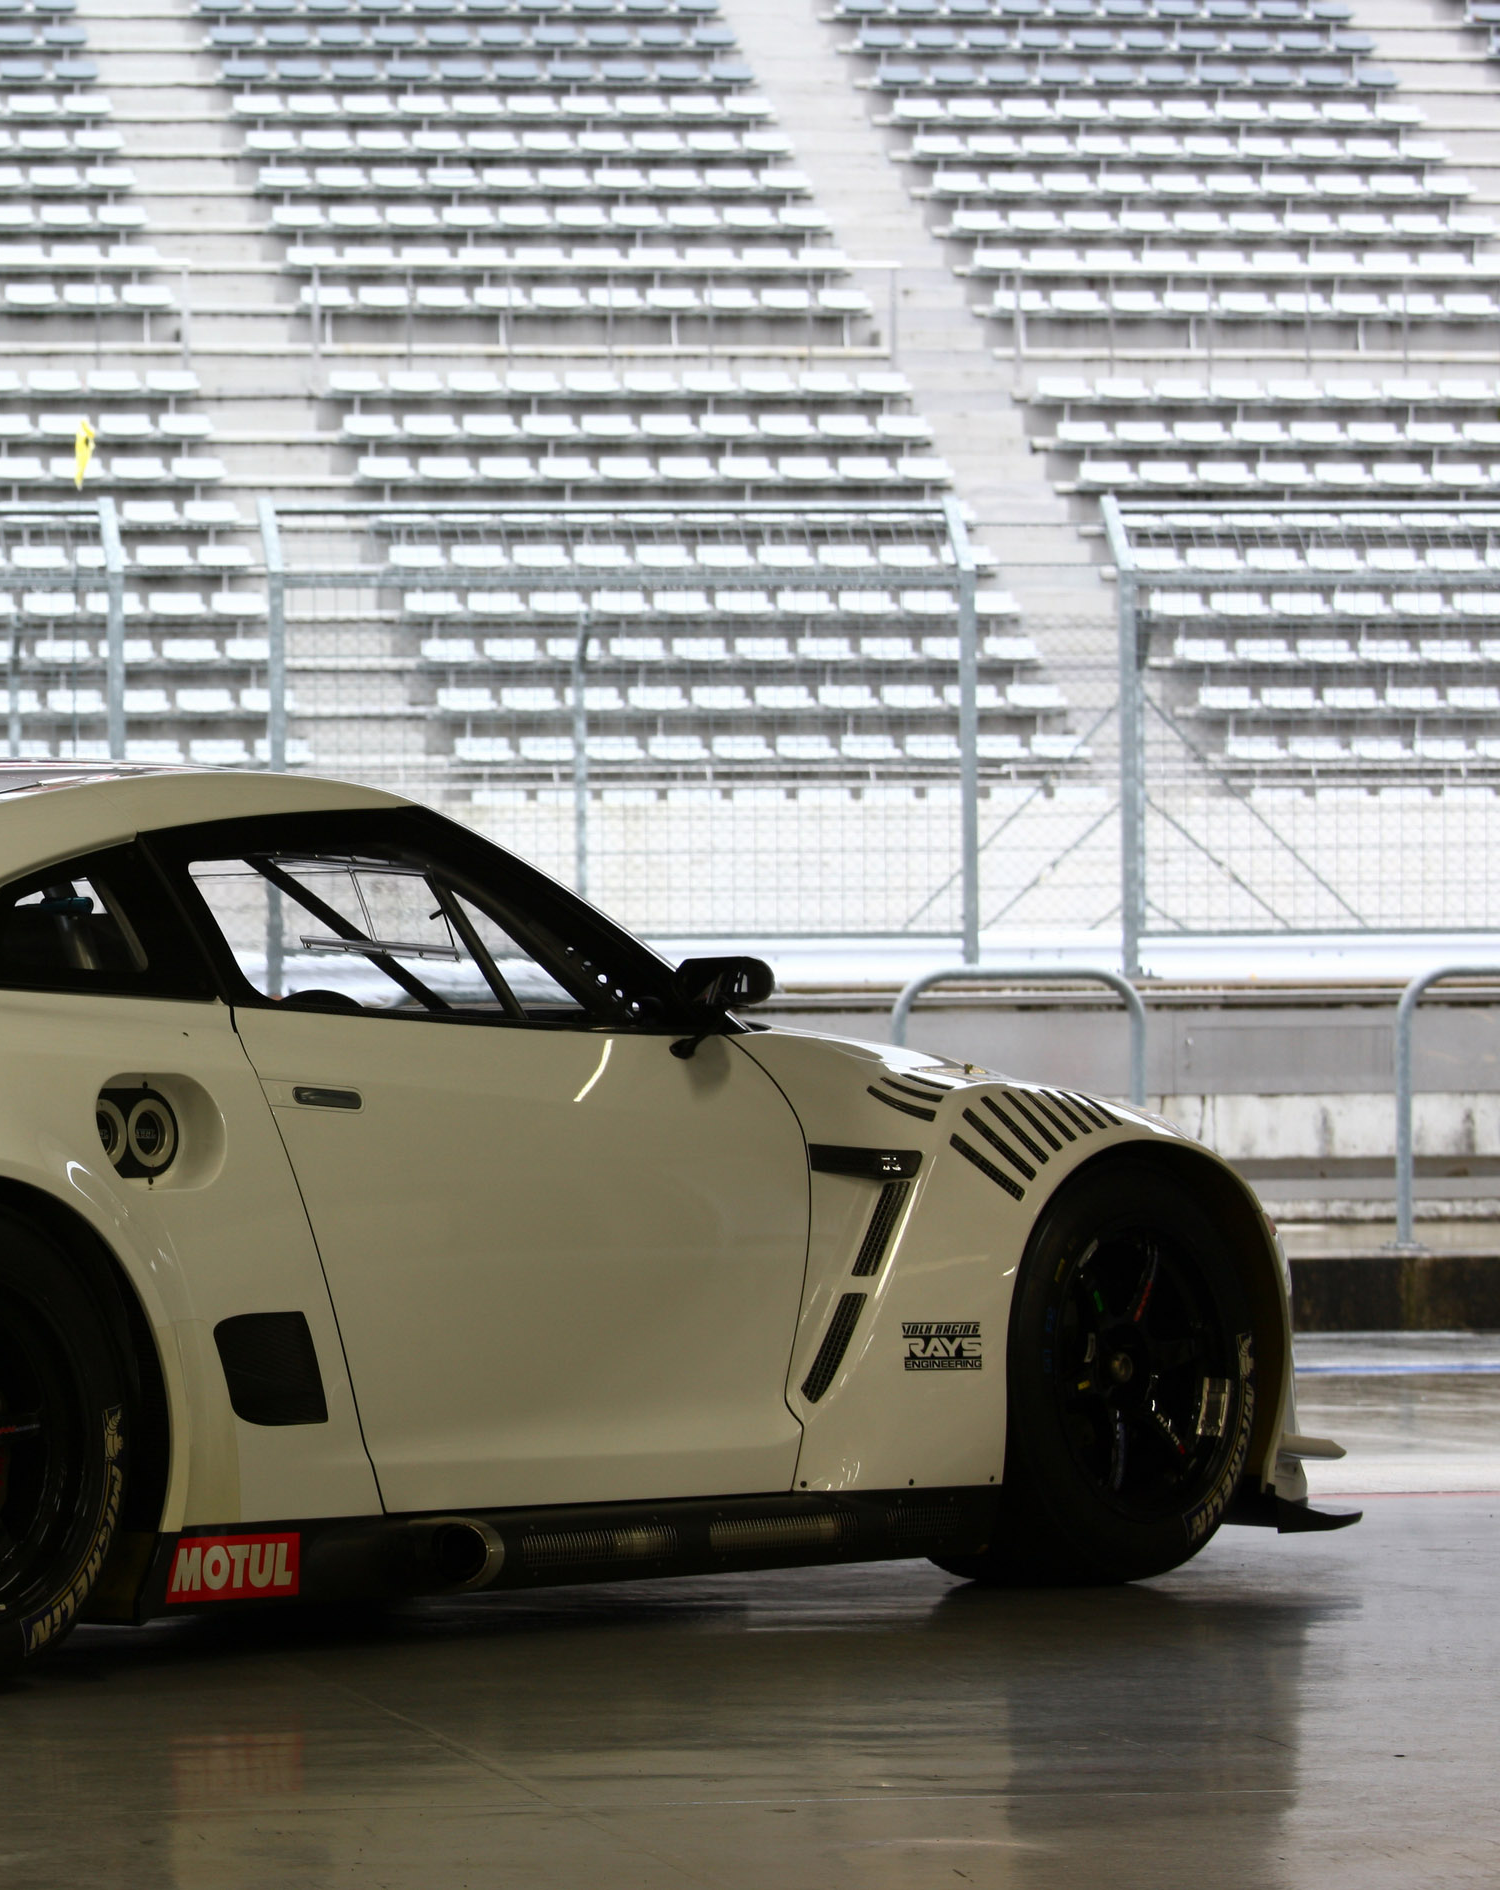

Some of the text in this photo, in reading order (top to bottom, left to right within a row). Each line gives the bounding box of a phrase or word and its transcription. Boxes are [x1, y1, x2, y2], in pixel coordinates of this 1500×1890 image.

[903, 1336, 982, 1358] RAYS
[935, 1324, 980, 1335] RACING
[904, 1359, 982, 1369] ENGINEERING
[1190, 1383, 1254, 1541] MICHELIN
[29, 1462, 123, 1651] MICHELIN
[170, 1541, 293, 1594] MOTUL
